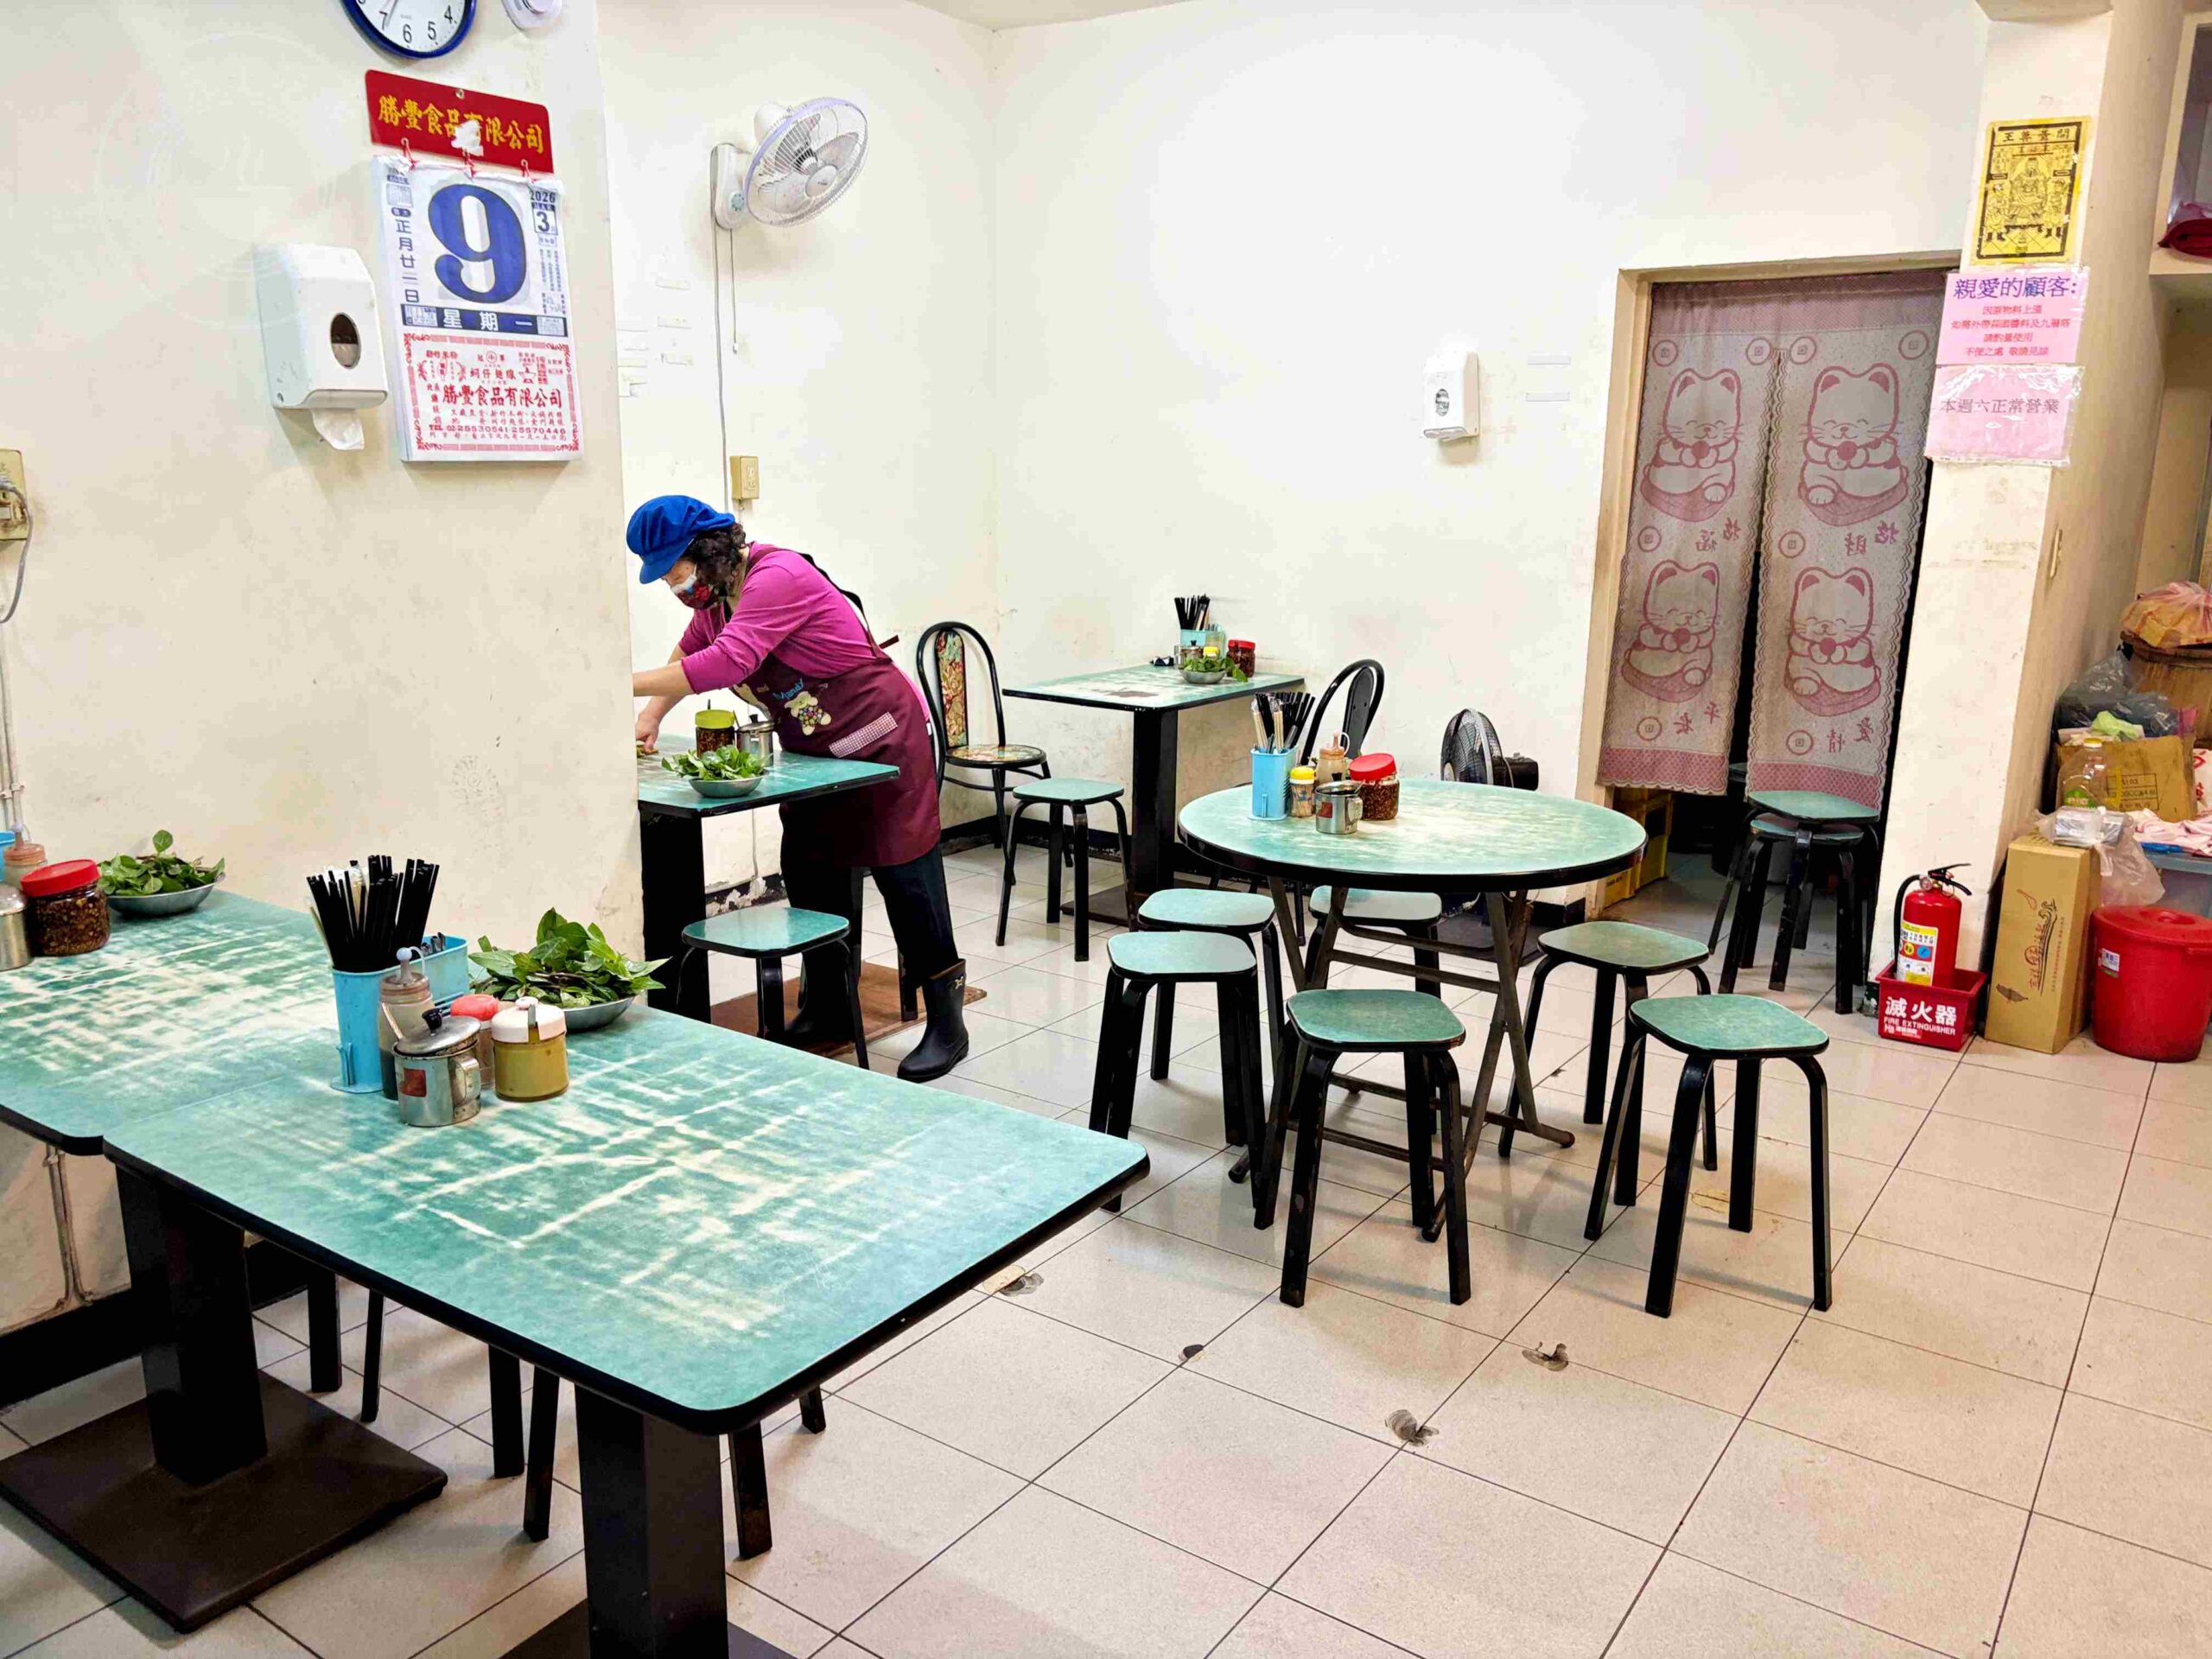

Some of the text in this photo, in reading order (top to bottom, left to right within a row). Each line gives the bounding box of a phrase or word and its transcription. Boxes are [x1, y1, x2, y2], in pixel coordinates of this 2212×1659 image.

[378, 11, 387, 30] 7
[444, 5, 454, 25] 4
[403, 24, 412, 43] 6
[428, 22, 436, 40] 5
[530, 190, 556, 202] 2026
[537, 211, 550, 232] 3
[428, 184, 527, 304] 9
[443, 308, 533, 331] 星期一
[442, 385, 563, 408] 勝豐食品有限公司
[1940, 398, 2060, 414] 本週六正常營業
[1885, 995, 1957, 1027] 滅火器
[1884, 1016, 1900, 1026] FIRE
[1902, 1019, 1956, 1036] EXTINGUISHER
